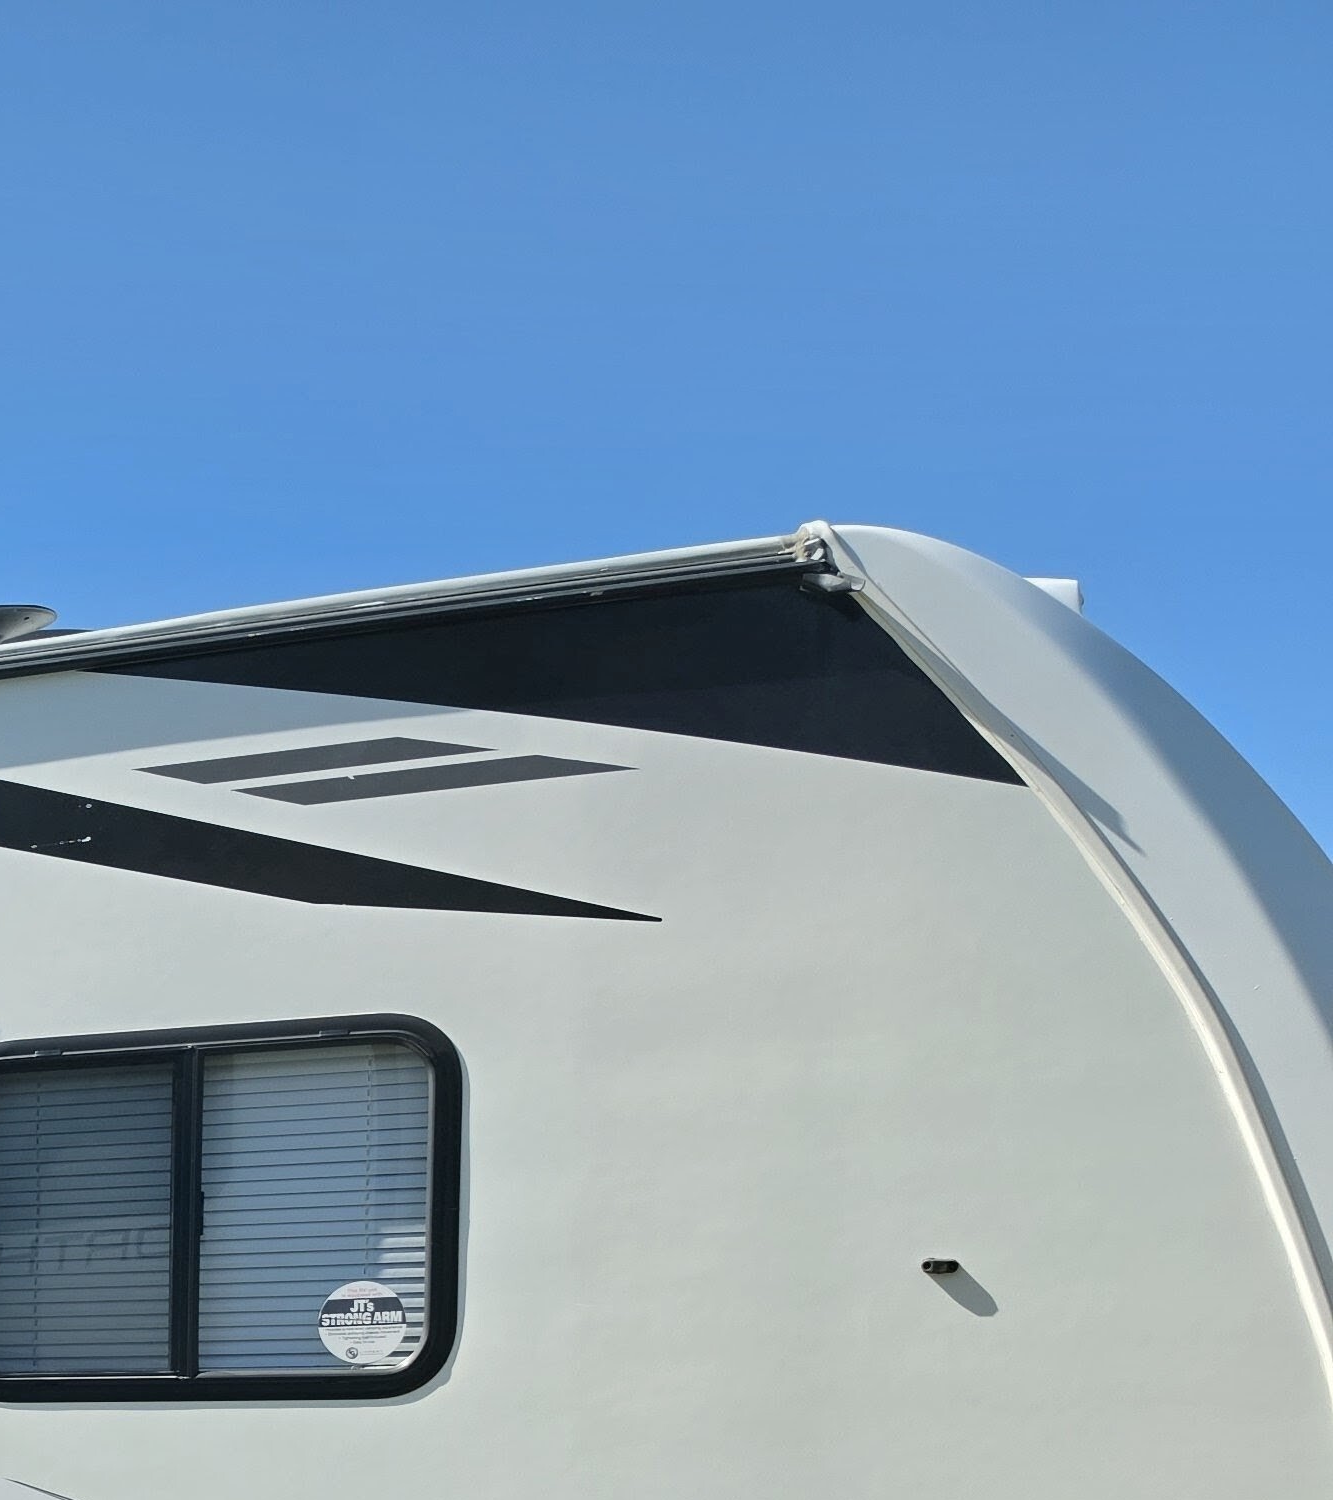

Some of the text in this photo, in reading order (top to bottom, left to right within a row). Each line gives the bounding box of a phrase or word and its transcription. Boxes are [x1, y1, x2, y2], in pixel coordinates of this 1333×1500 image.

[350, 1299, 375, 1312] JT's
[321, 1311, 402, 1326] STRONG ARM
